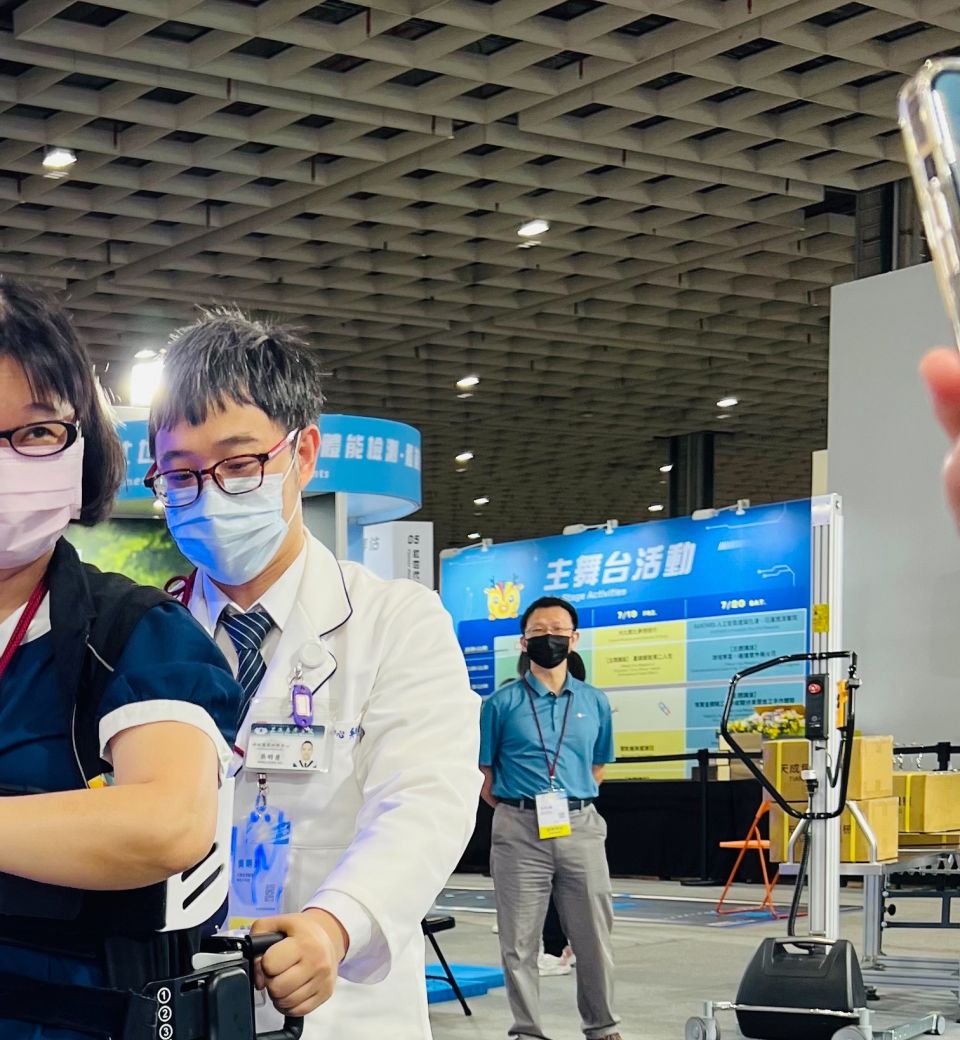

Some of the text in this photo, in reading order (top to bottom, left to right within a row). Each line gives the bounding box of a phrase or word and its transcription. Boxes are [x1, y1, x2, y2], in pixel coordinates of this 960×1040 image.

[543, 541, 697, 592] 主舞台活動
